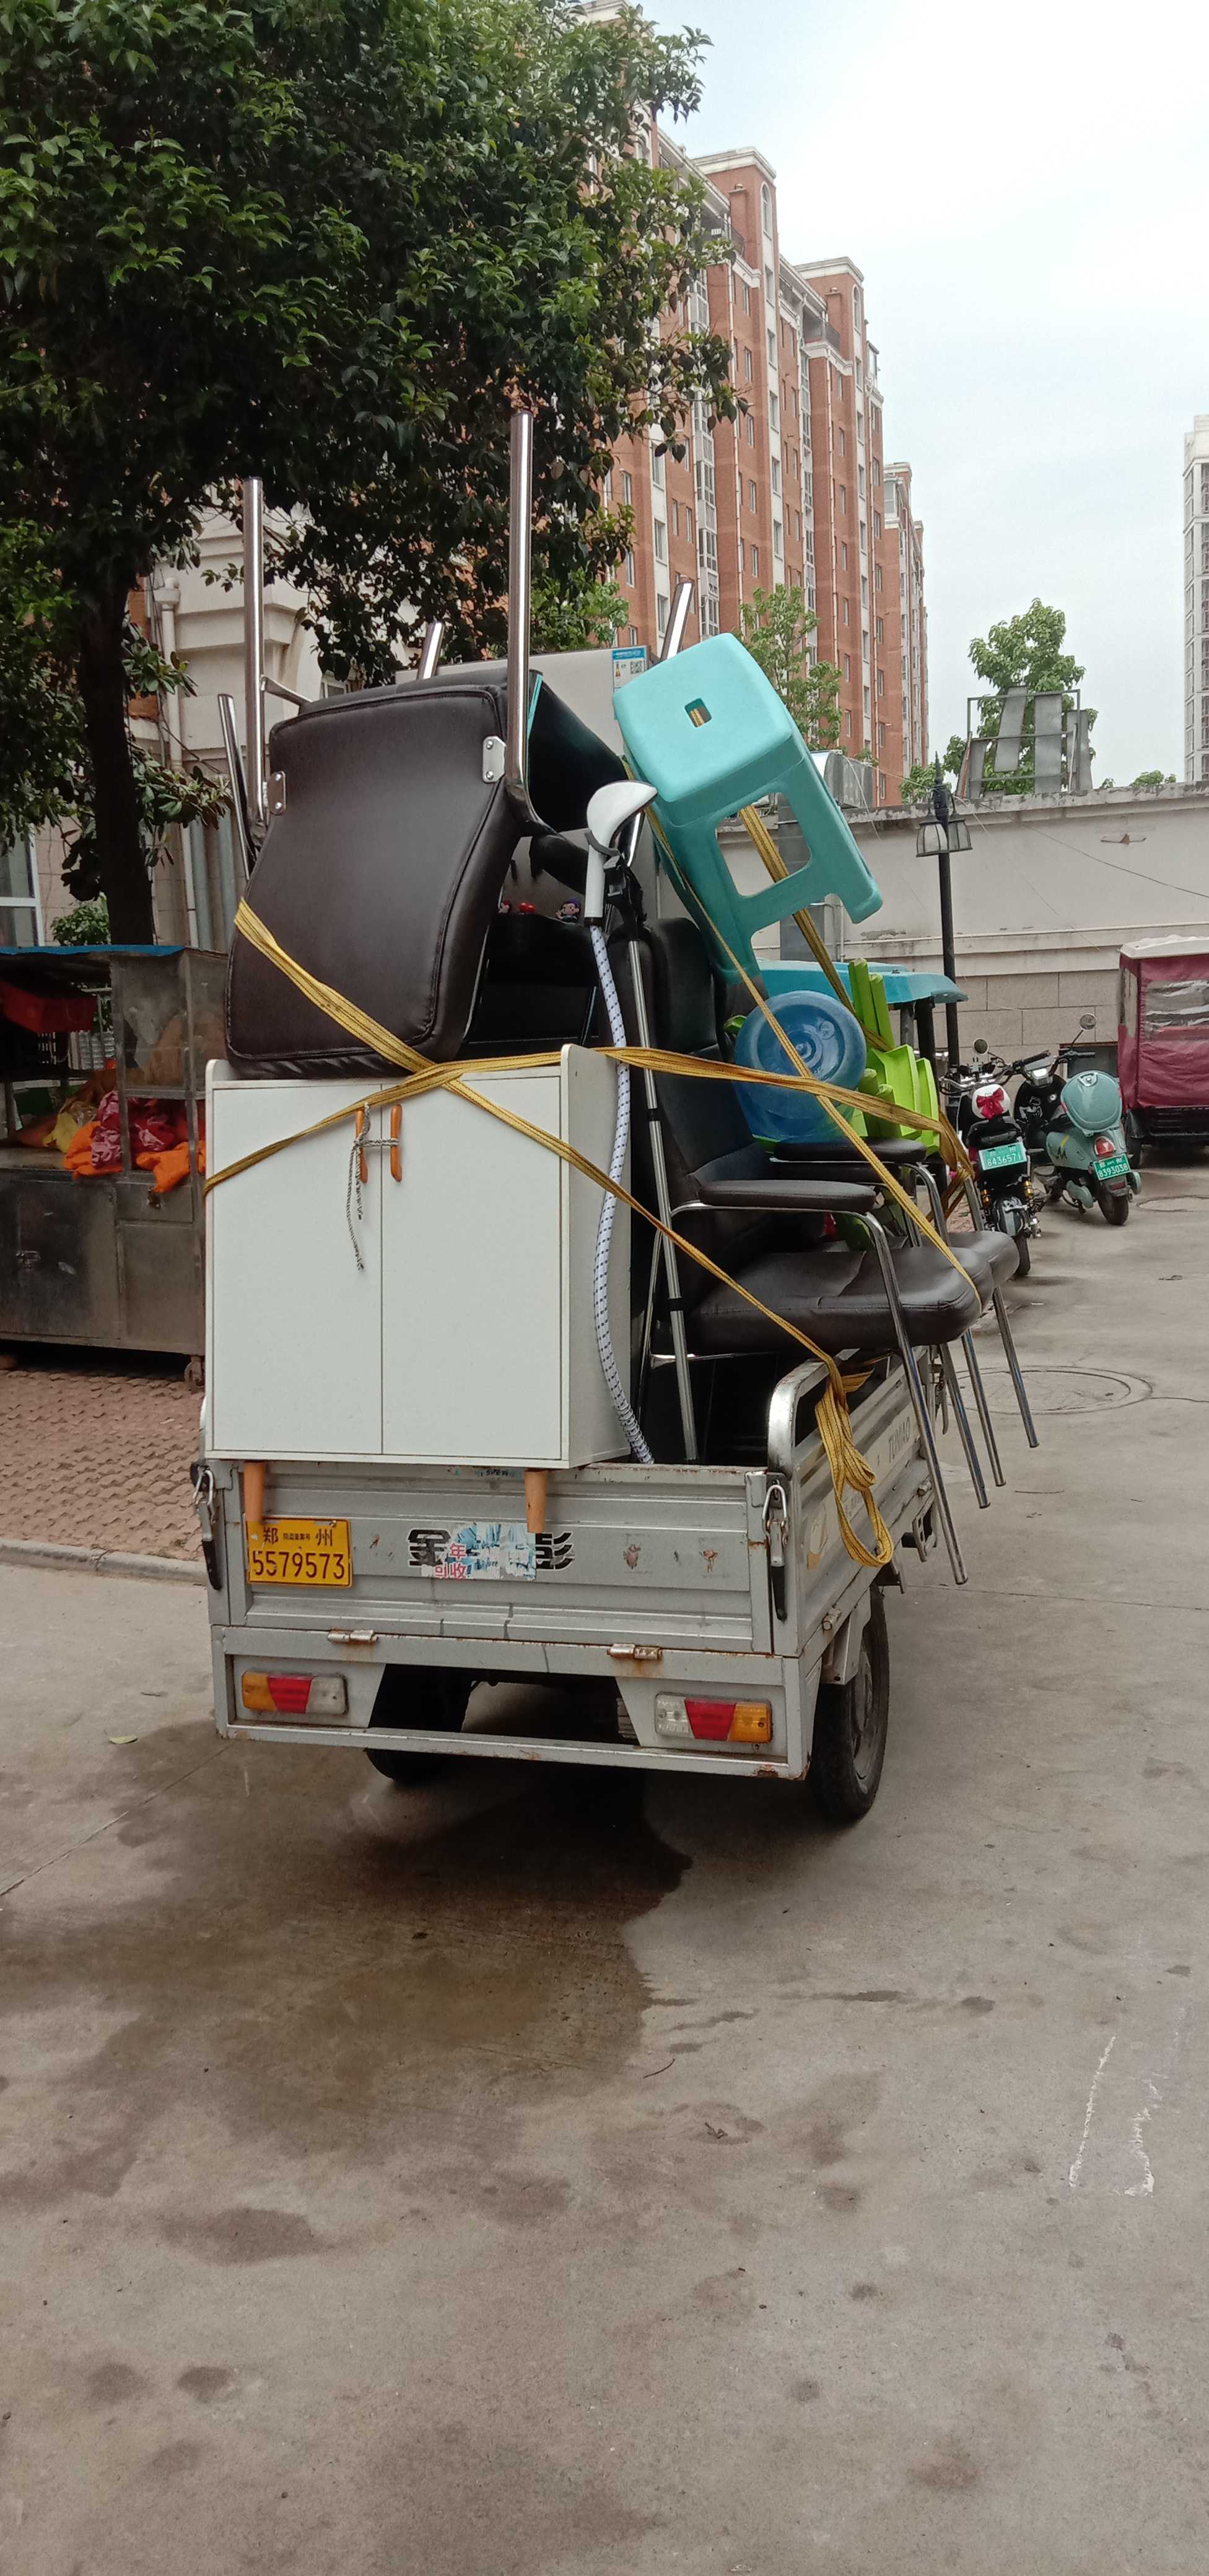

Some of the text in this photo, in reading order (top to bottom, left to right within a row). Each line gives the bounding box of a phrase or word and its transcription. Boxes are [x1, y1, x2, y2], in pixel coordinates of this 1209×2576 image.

[986, 1152, 1021, 1167] 8436571
[1098, 1163, 1128, 1178] 8393038
[263, 1526, 279, 1545] 郑
[315, 1528, 333, 1547] 州
[252, 1550, 346, 1580] 5579573
[435, 1562, 466, 1578] 回收
